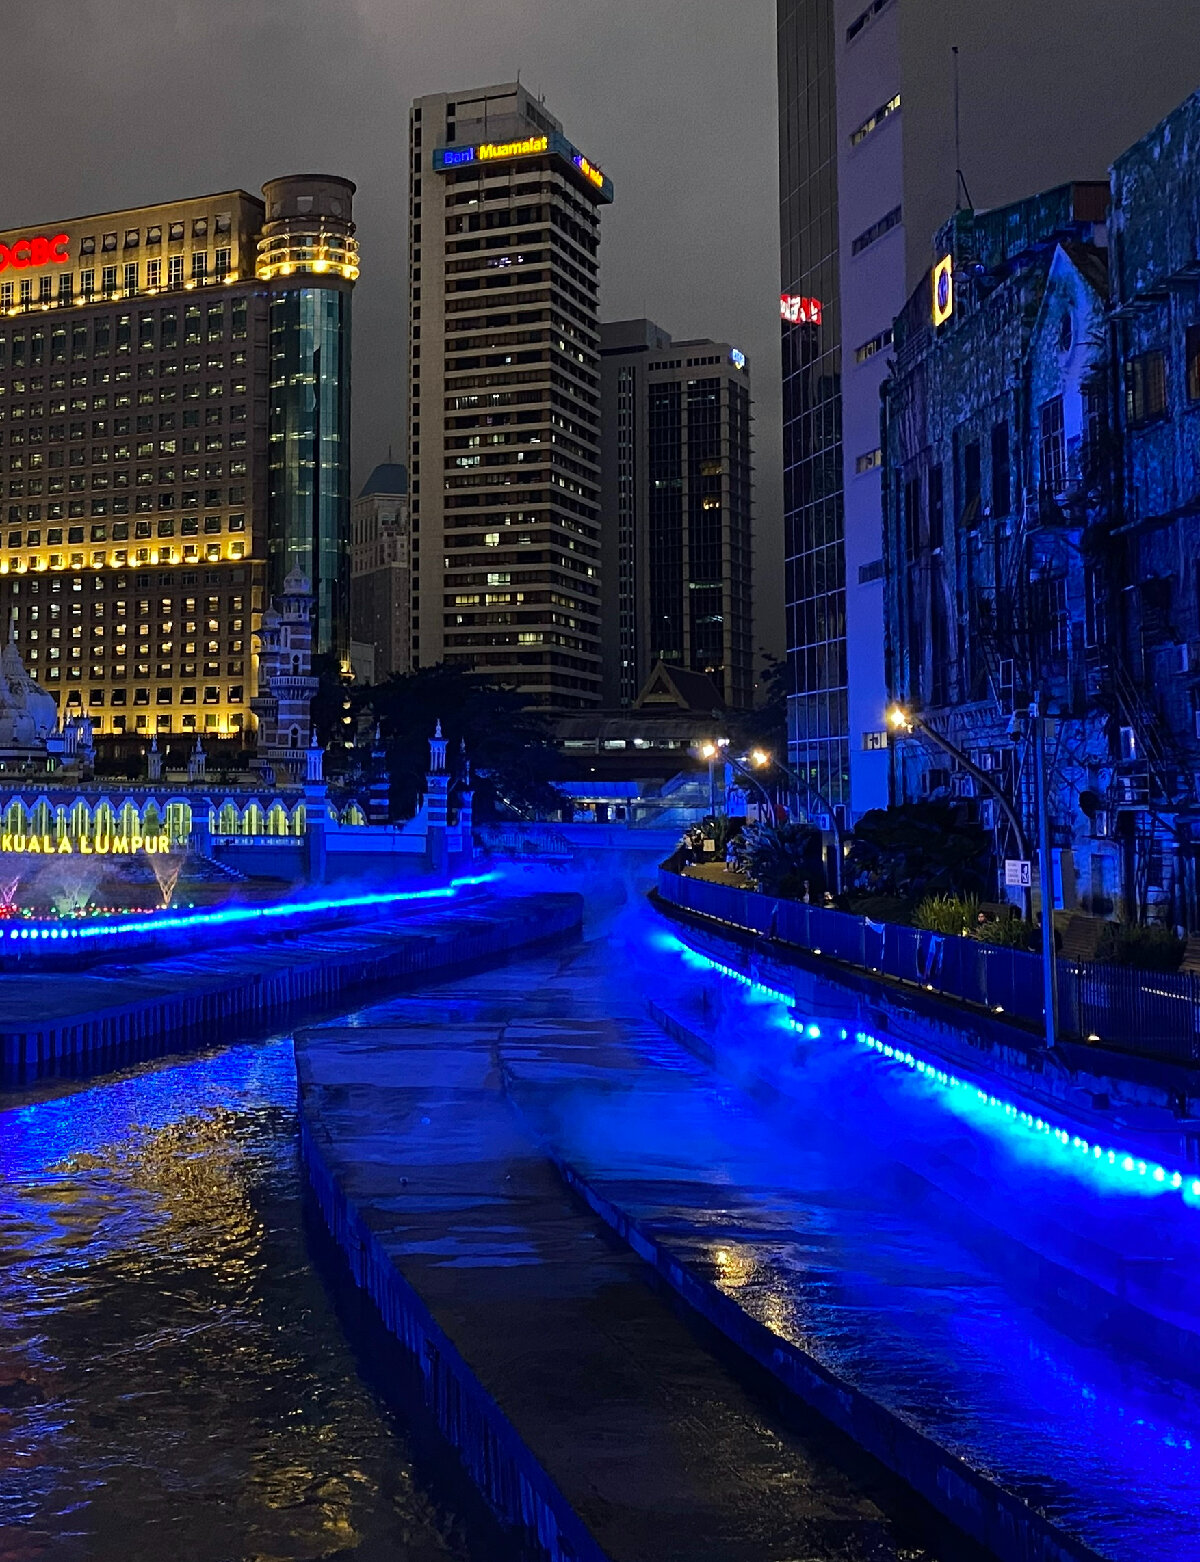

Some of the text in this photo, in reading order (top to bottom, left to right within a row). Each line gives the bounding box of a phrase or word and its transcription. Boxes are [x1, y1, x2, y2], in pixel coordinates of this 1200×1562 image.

[479, 136, 548, 160] Muamalat
[2, 834, 170, 854] KUALA LUMPUR
